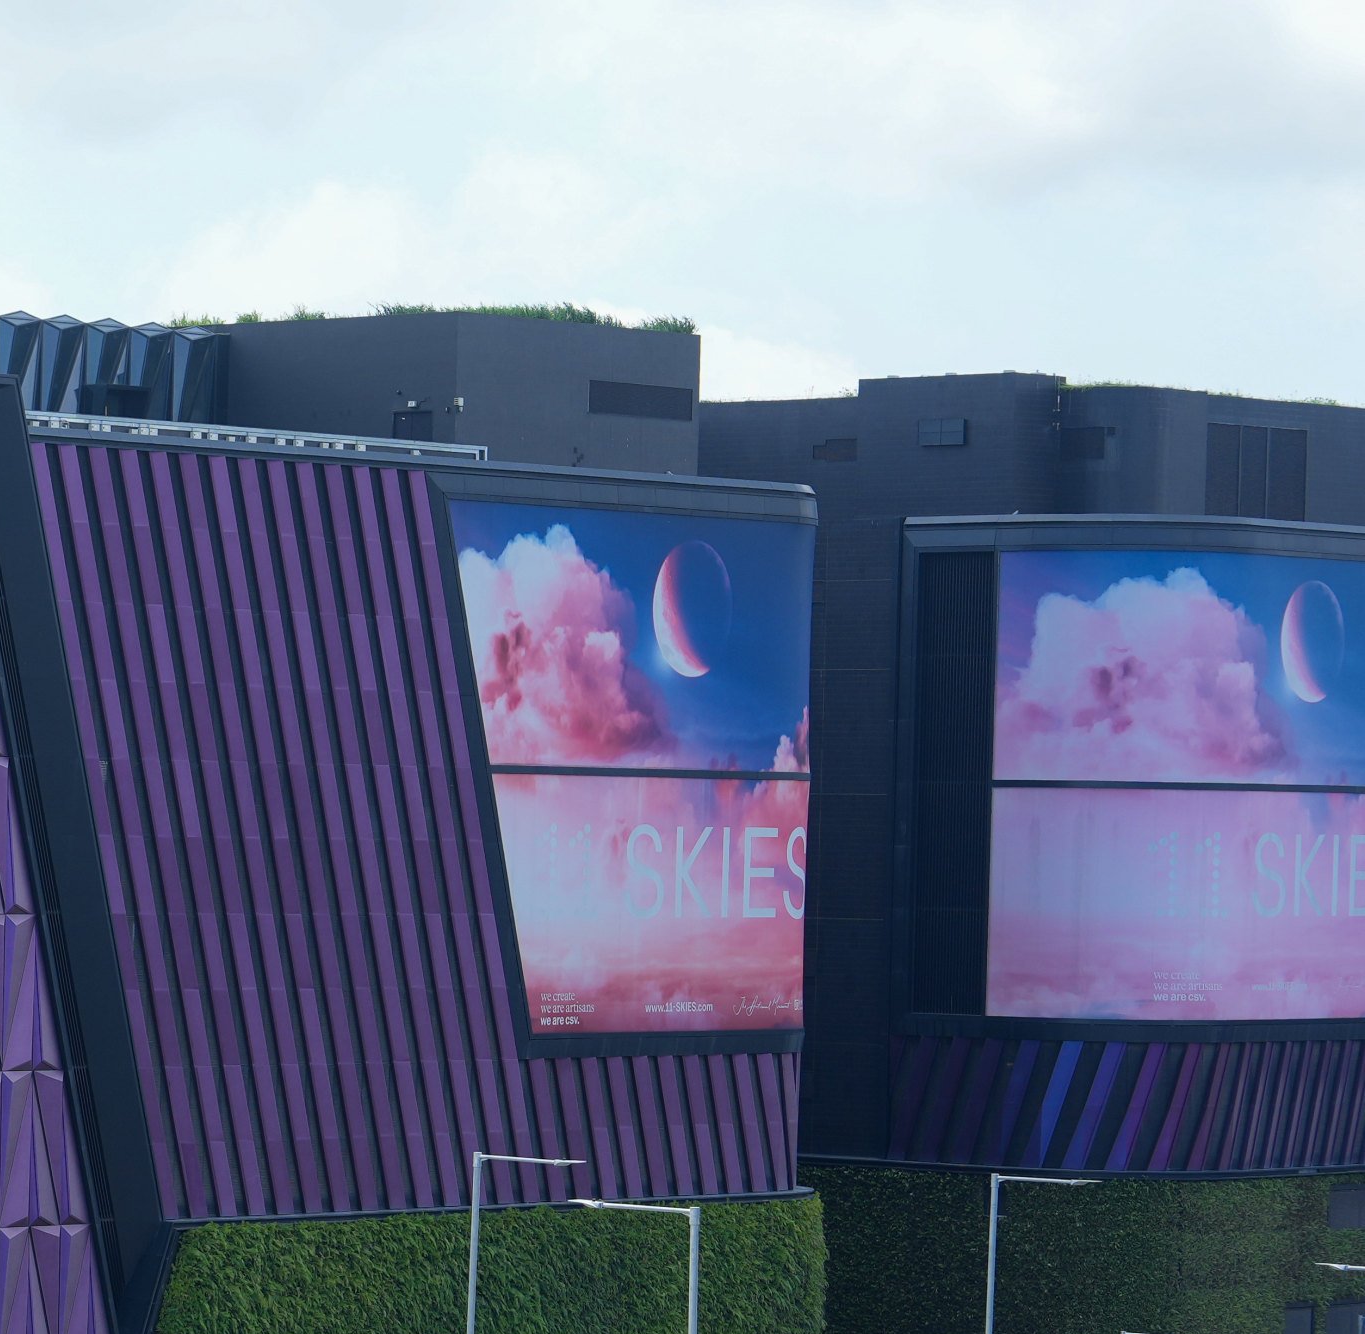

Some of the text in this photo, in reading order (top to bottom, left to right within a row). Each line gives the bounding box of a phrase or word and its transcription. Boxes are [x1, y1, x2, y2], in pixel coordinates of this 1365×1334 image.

[623, 823, 806, 919] SKIES
[1251, 832, 1365, 918] SKIE
[1154, 971, 1200, 980] we create
[1154, 981, 1223, 991] we are artisans
[541, 992, 576, 1001] we create
[1154, 992, 1206, 1001] we are csv.
[541, 1001, 595, 1013] we are artisans
[645, 1001, 713, 1013] www.11-SKIES.com
[541, 1016, 580, 1025] we are csv.
